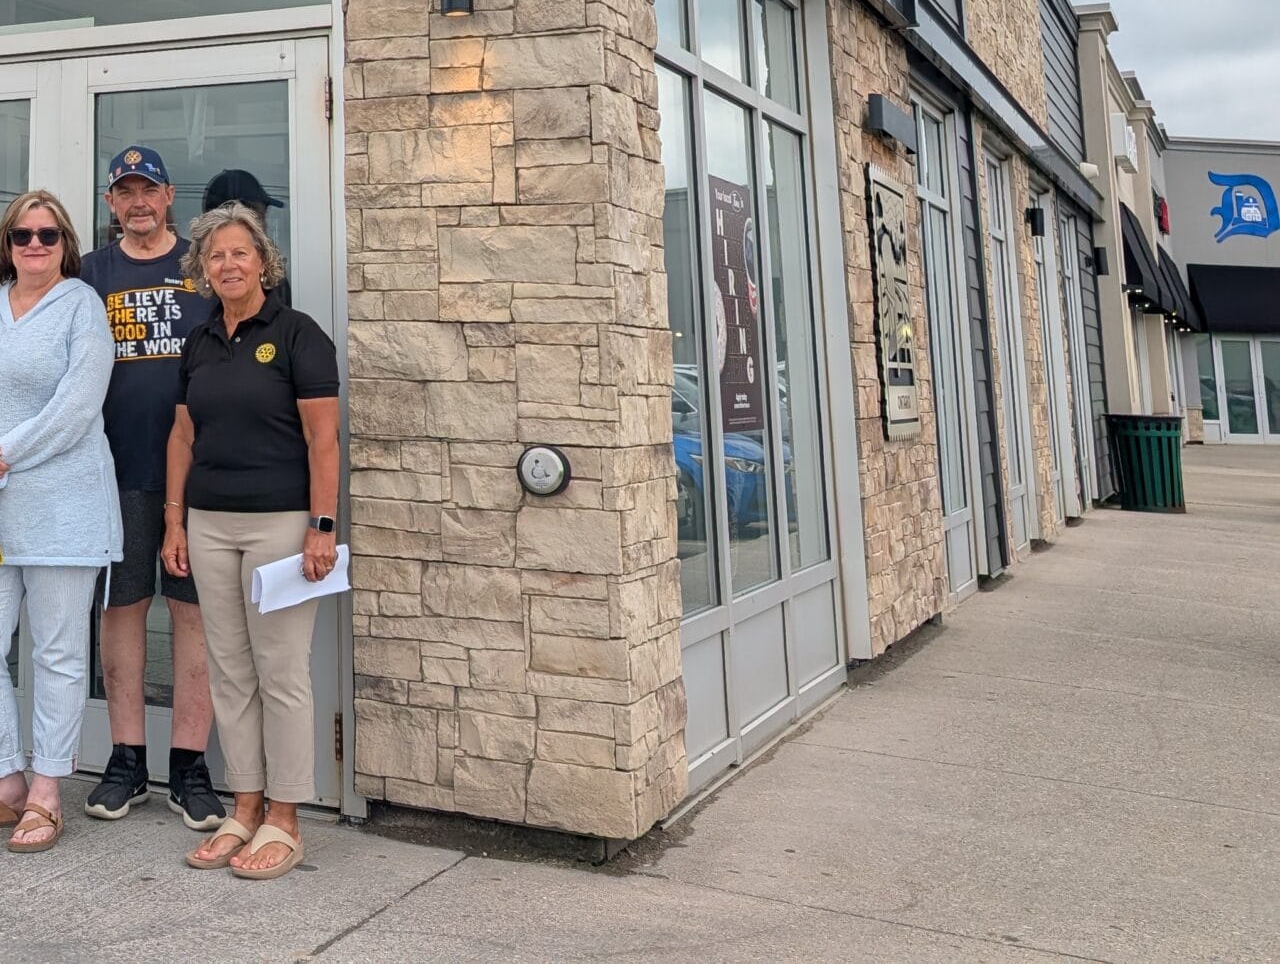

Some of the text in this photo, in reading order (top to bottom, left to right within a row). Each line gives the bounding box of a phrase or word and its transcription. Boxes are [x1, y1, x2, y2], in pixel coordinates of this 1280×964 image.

[107, 290, 176, 311] BELIEVE
[715, 208, 756, 384] HIRING
[107, 304, 182, 324] THERE IS
[111, 321, 172, 341] OOD IN
[115, 338, 186, 357] HE WOR
